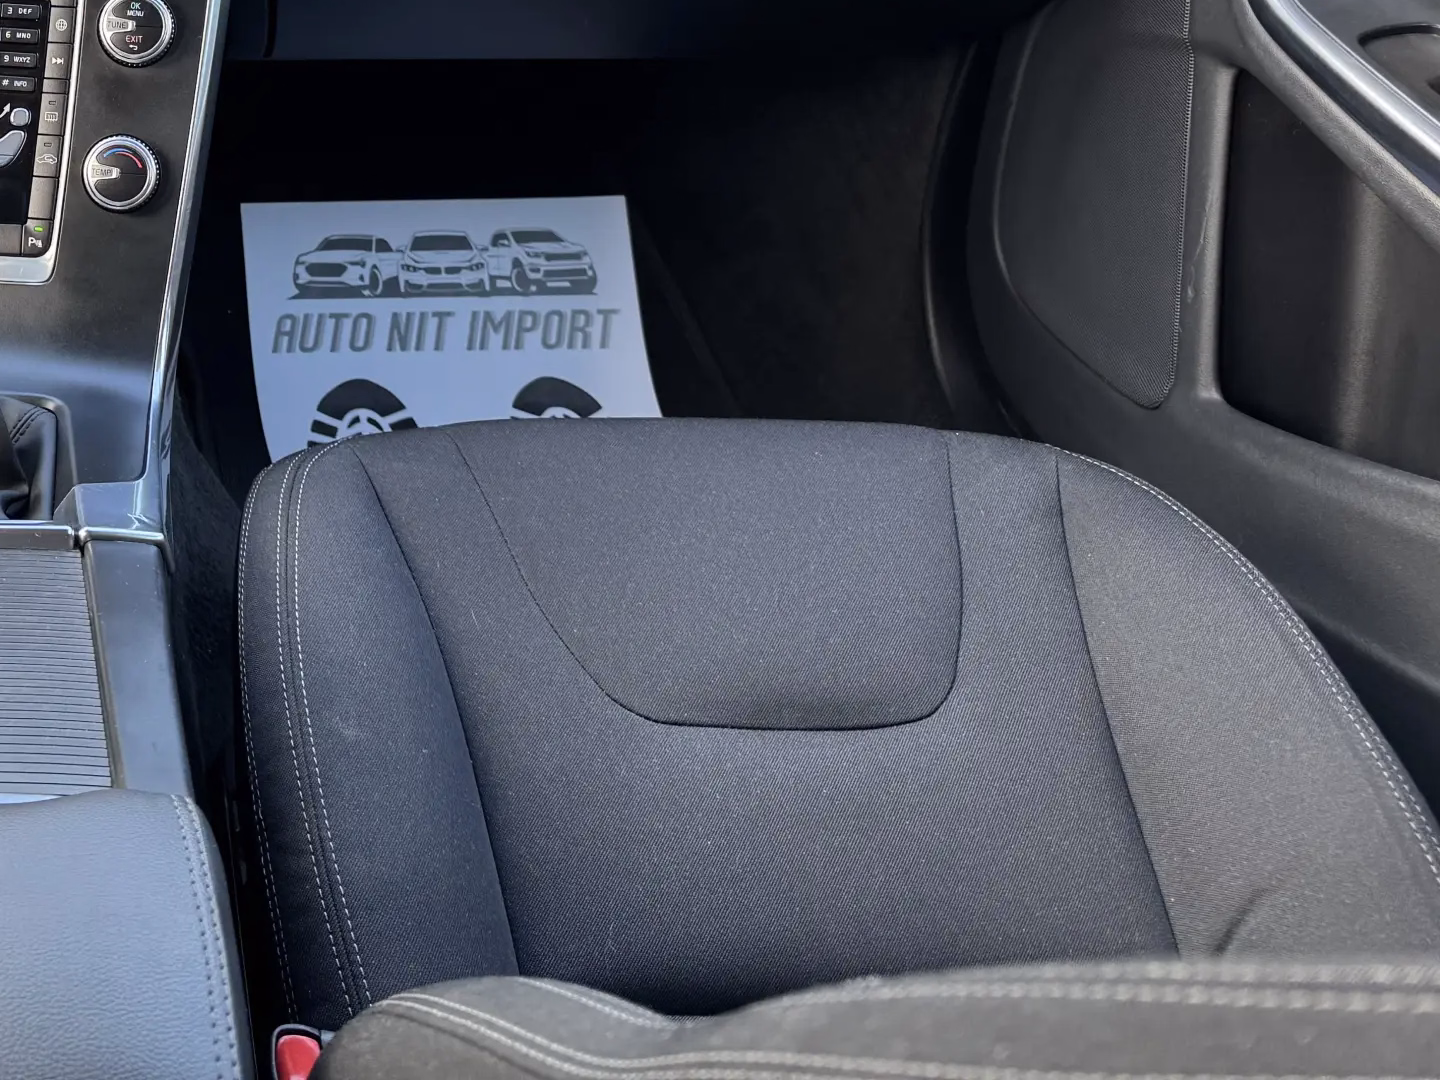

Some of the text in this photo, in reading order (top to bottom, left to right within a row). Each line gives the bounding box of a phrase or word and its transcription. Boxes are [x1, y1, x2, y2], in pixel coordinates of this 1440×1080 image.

[130, 2, 141, 10] OK
[107, 21, 127, 29] TUNE
[125, 35, 143, 43] EXIT
[92, 168, 111, 176] TEMP
[271, 308, 621, 354] AUTO NIT IMPORT
